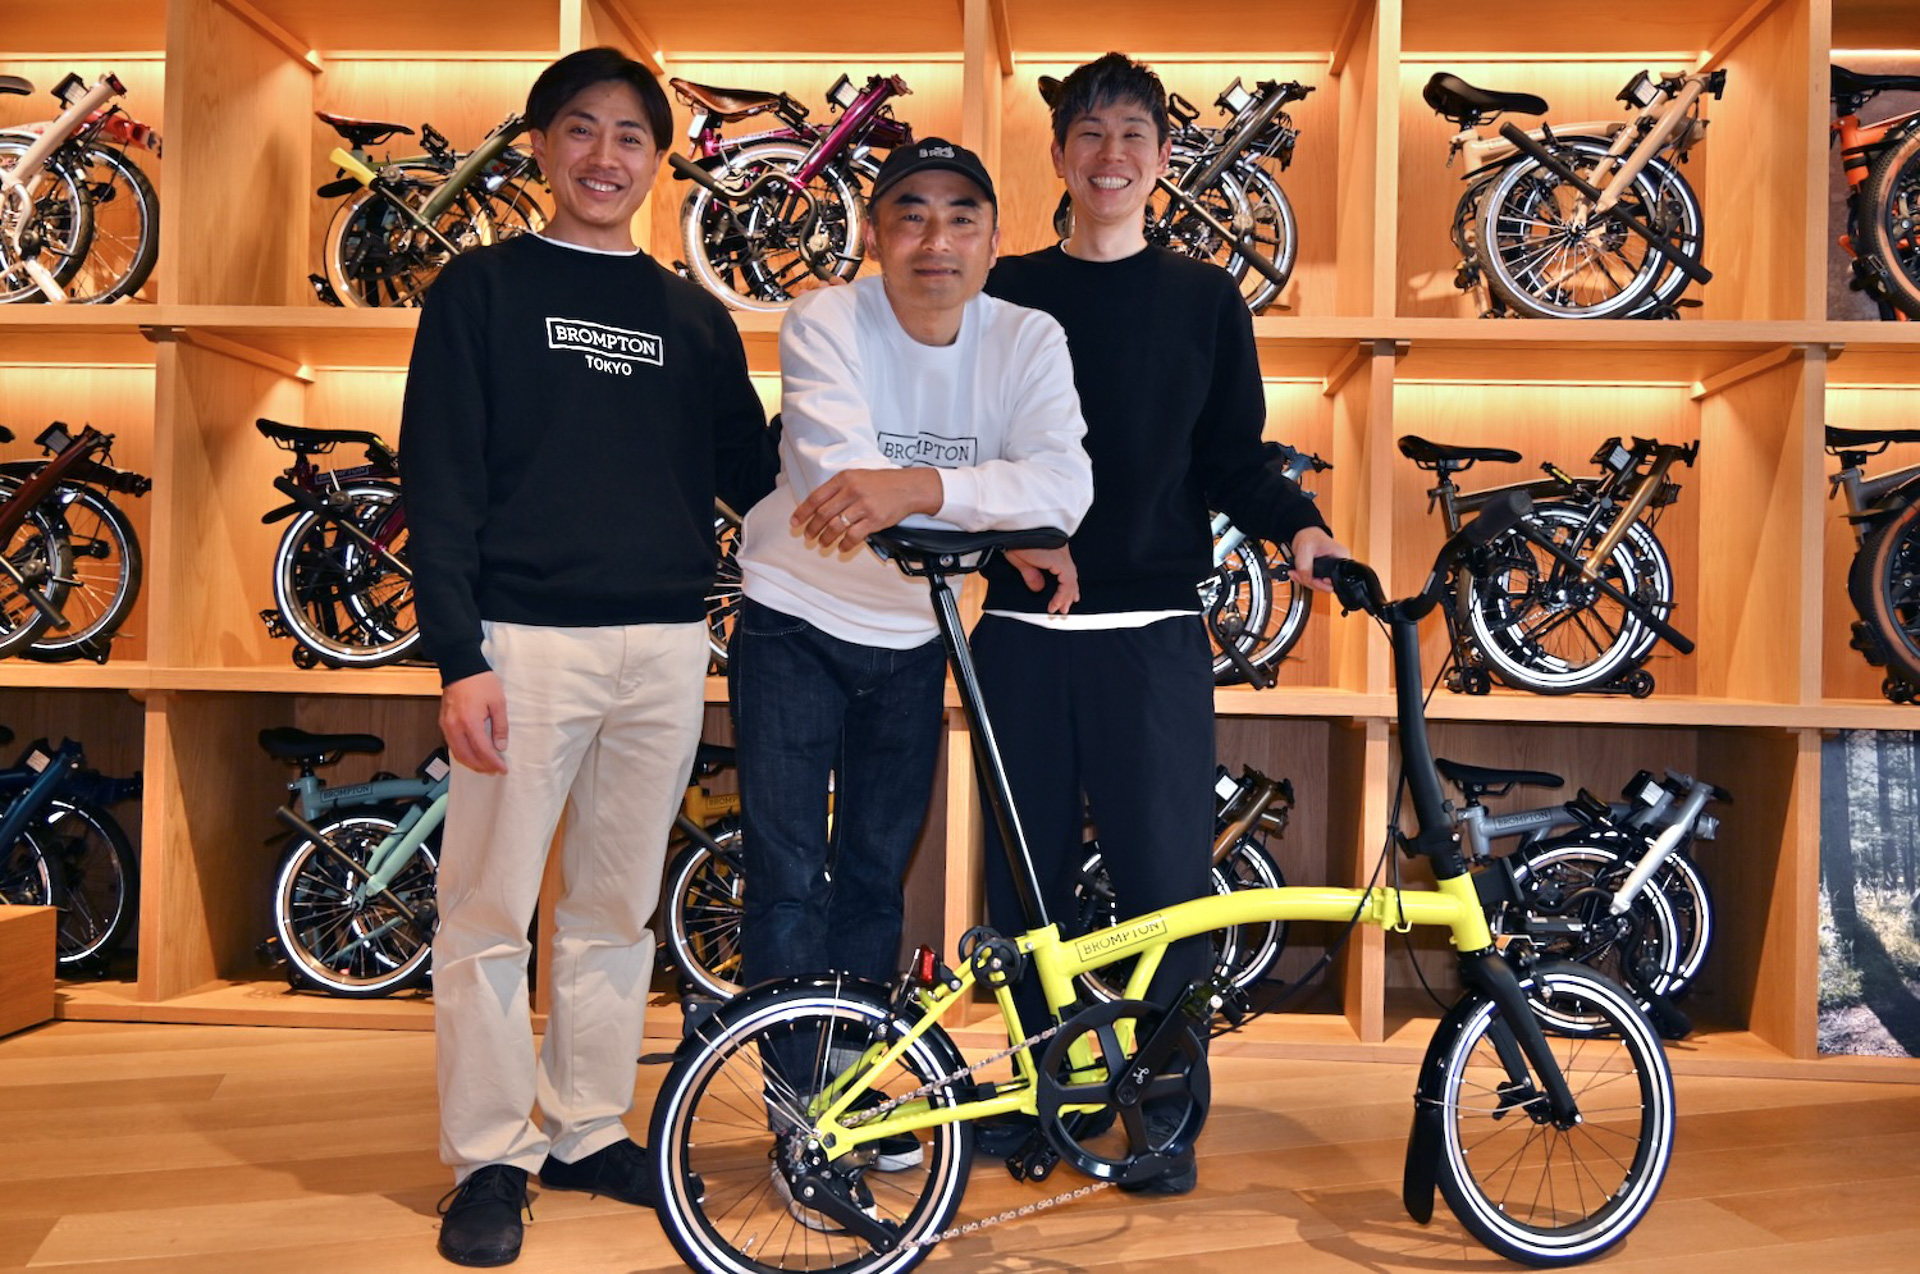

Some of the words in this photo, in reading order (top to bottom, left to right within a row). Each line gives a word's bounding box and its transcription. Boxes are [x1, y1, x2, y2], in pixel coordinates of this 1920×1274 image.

[555, 325, 656, 356] BROMPTON
[584, 354, 632, 376] TOKYO
[1082, 922, 1160, 955] BROMPTON
